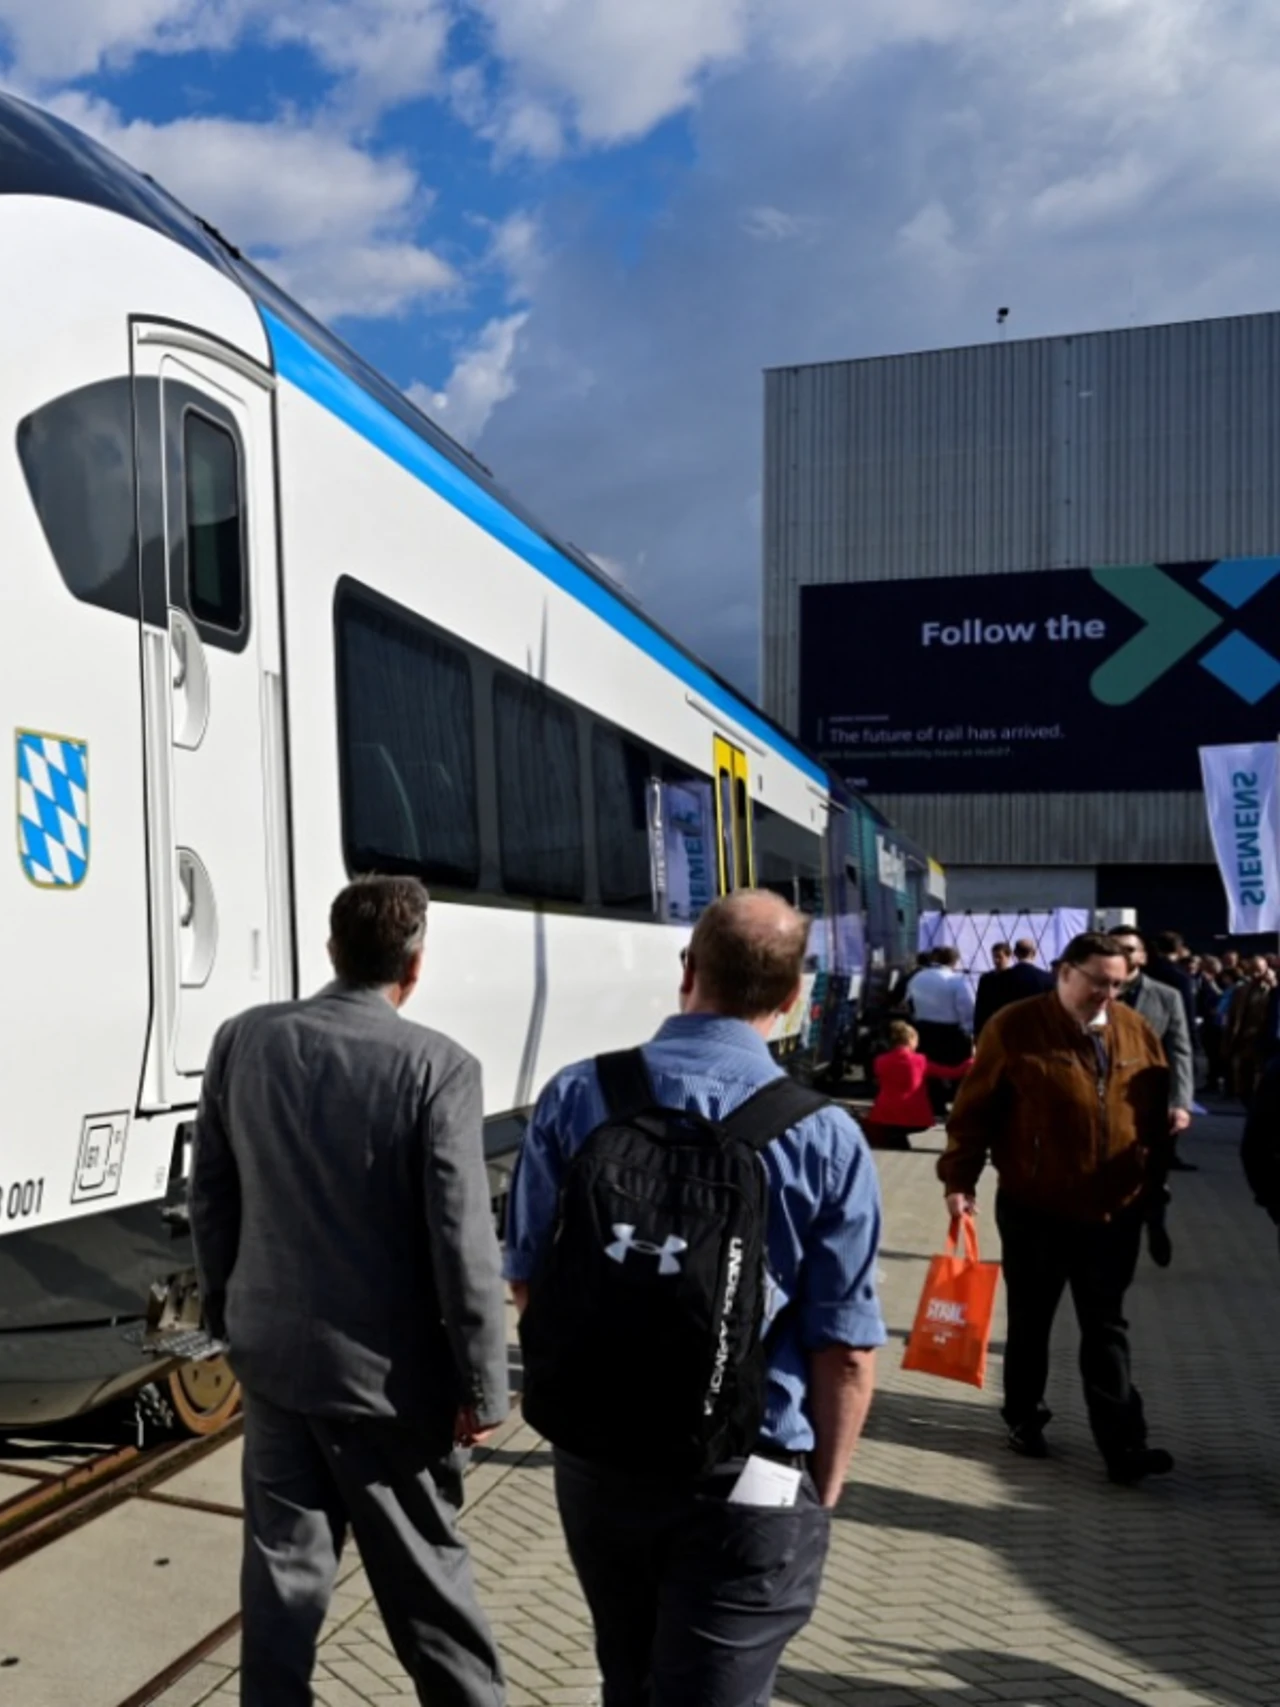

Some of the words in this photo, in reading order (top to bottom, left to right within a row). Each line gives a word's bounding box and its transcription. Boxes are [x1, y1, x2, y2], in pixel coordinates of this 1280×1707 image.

[921, 617, 1037, 647] Follow
[1044, 614, 1106, 641] the
[829, 727, 859, 744] The
[862, 726, 913, 744] future
[915, 725, 935, 742] of
[937, 724, 963, 742] rail
[967, 724, 998, 740] has
[1000, 721, 1066, 740] arrived.
[5, 1177, 44, 1220] 001
[723, 1236, 743, 1316] UNDER
